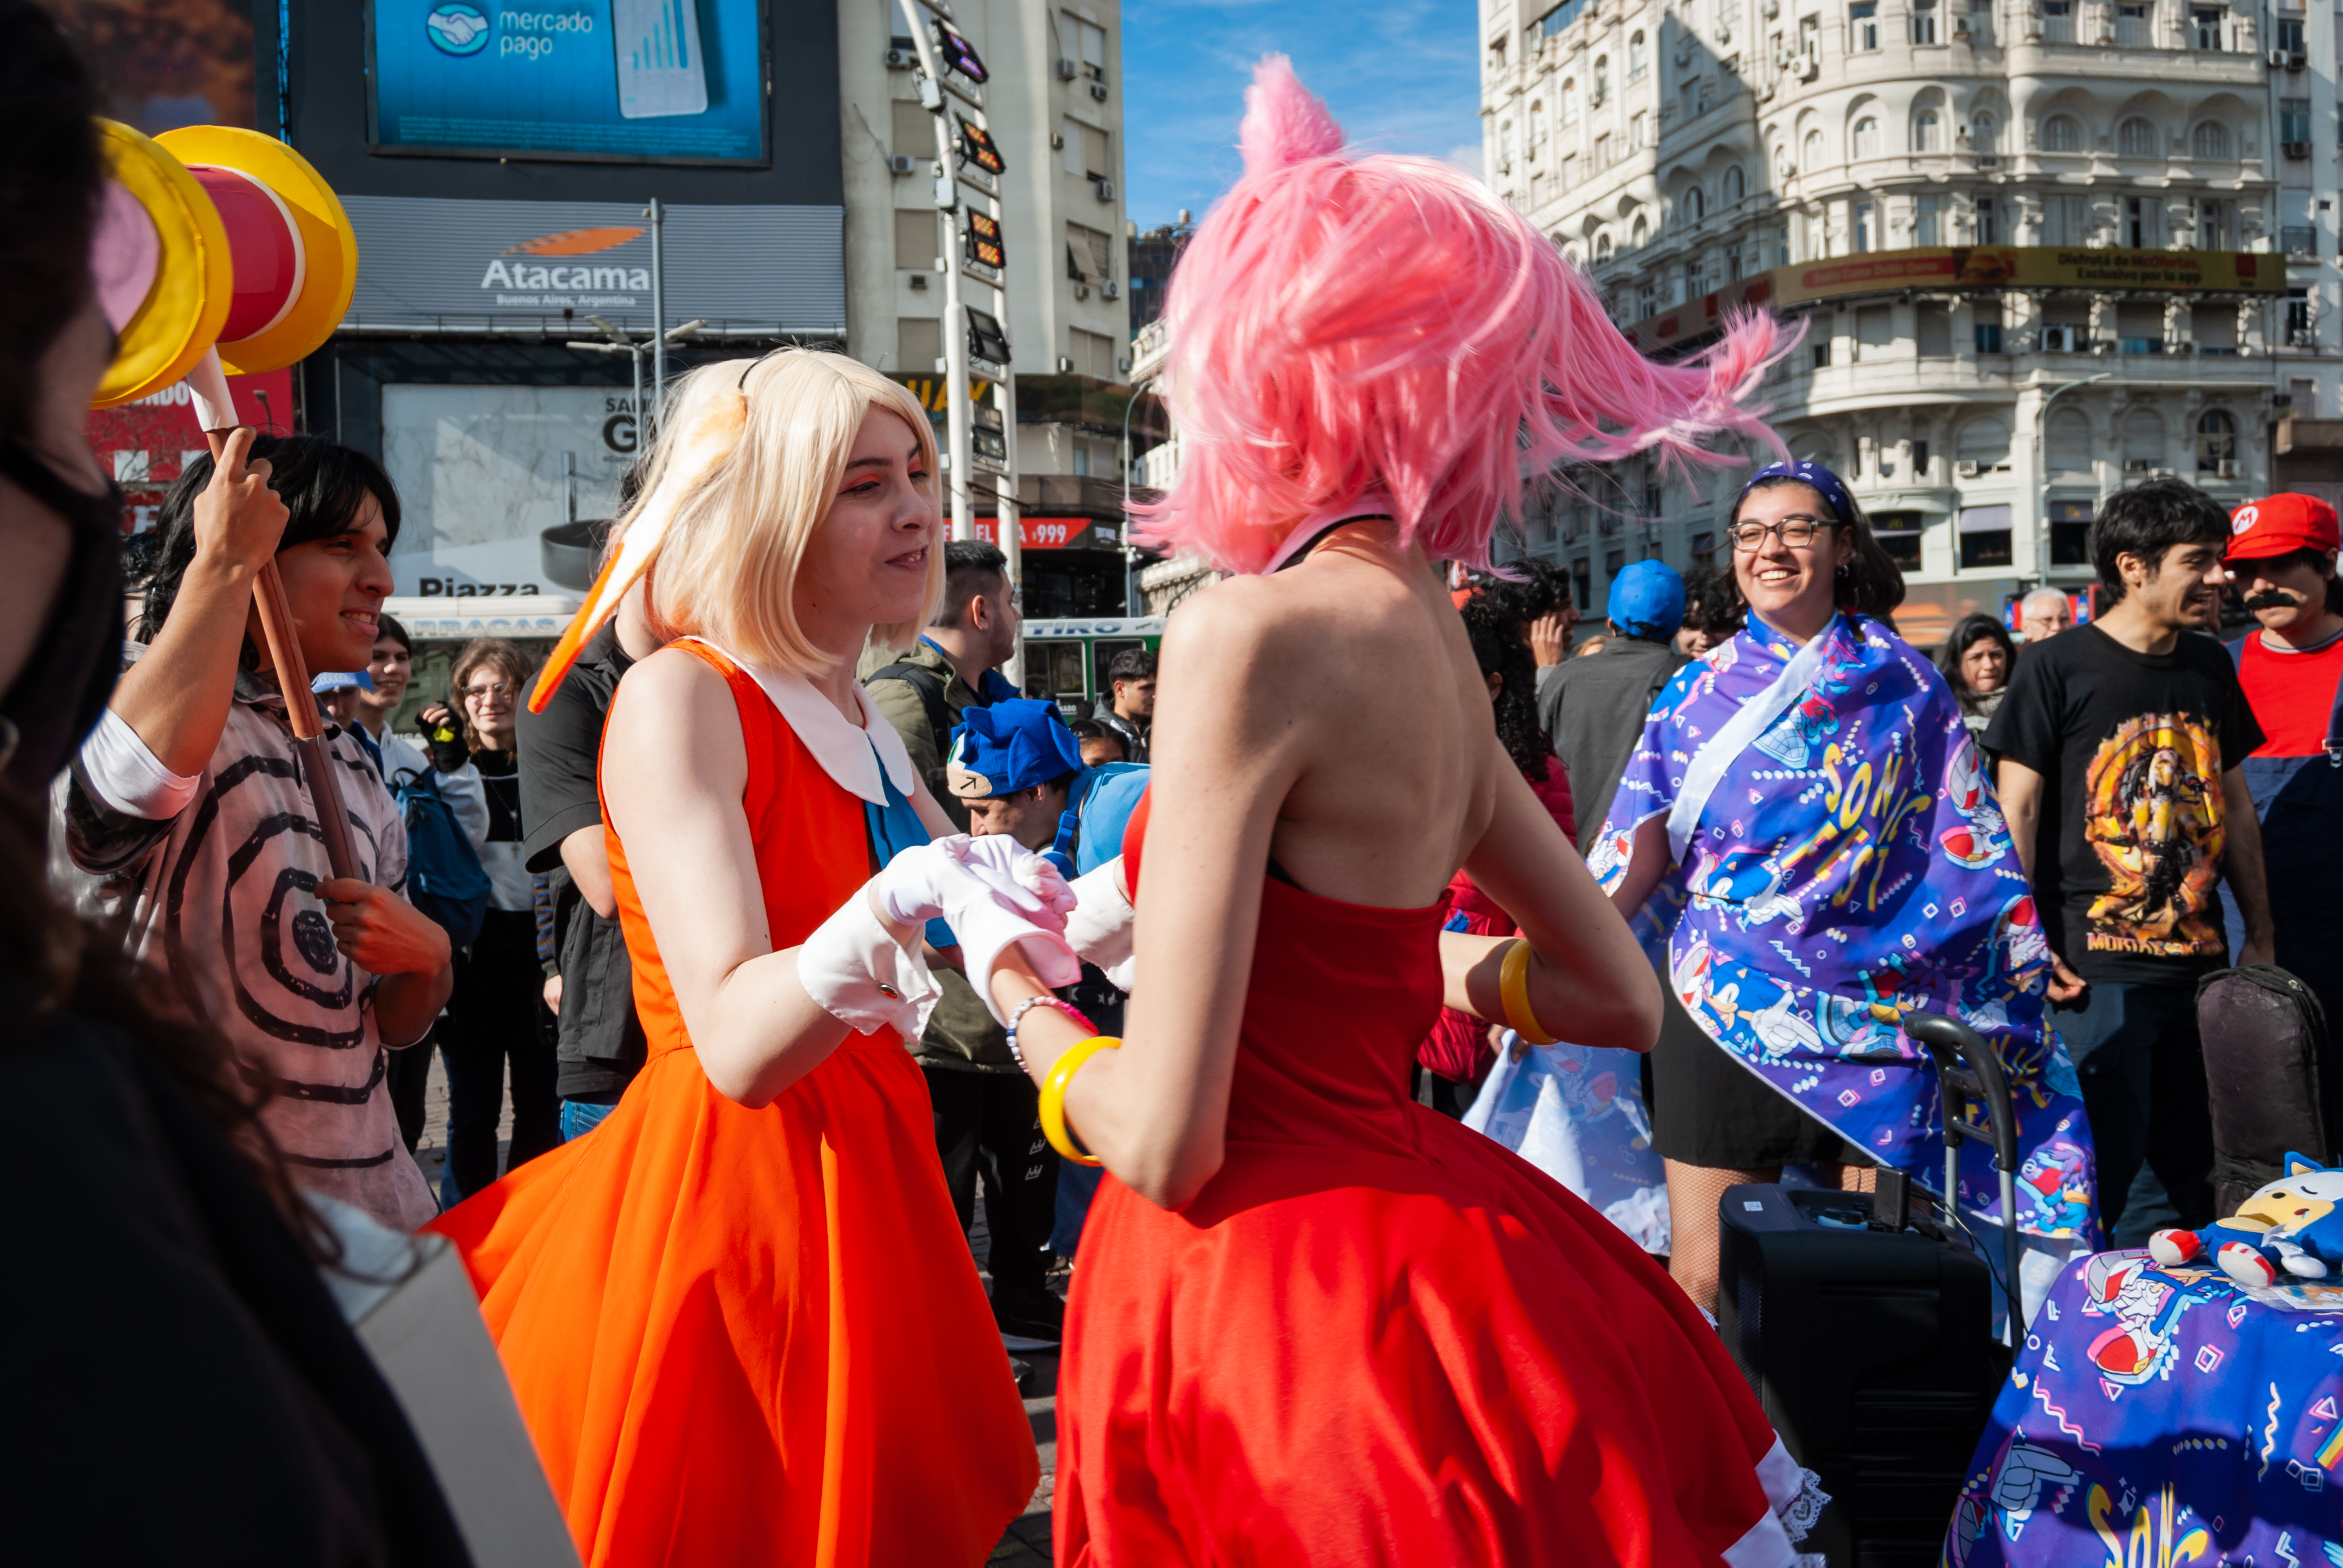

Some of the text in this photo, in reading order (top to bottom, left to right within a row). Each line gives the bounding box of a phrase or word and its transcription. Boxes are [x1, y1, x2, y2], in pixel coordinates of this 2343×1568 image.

[500, 10, 593, 32] mercado
[500, 35, 552, 60] pago
[480, 260, 650, 290] Atacama
[496, 294, 539, 304] Buenos
[578, 295, 635, 307] Argentina
[2235, 511, 2252, 530] M
[1032, 524, 1067, 543] $999
[419, 577, 539, 597] Piazza
[1027, 621, 1123, 635] TIRO
[1823, 740, 1932, 845] SONIC
[1780, 820, 1890, 912] FEST
